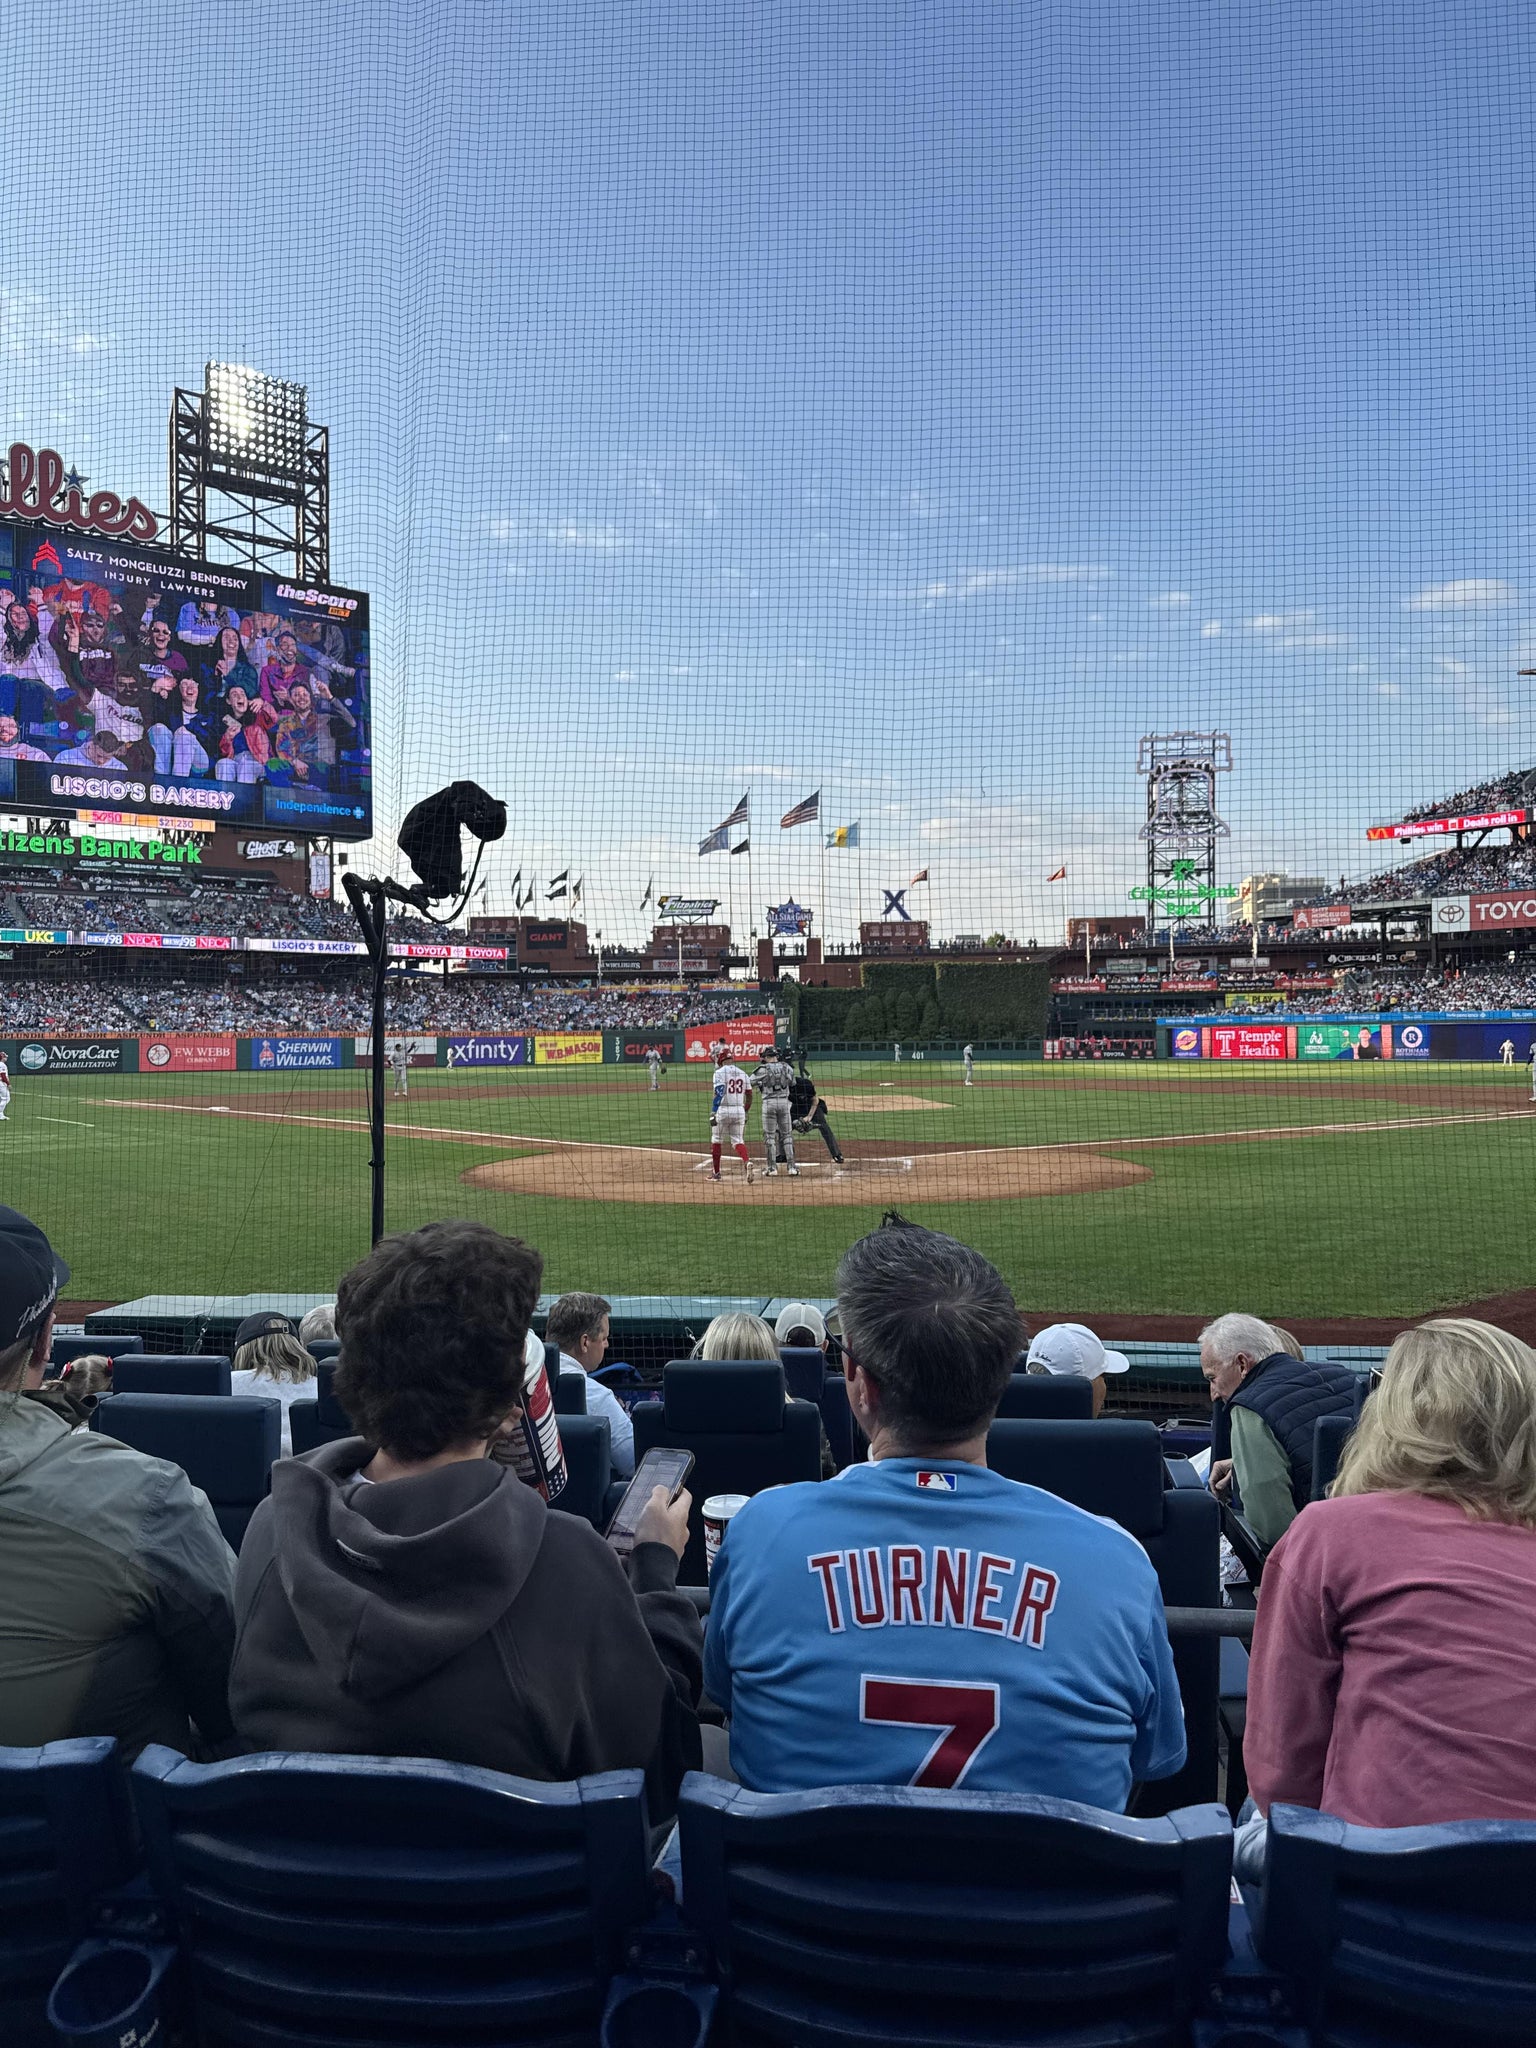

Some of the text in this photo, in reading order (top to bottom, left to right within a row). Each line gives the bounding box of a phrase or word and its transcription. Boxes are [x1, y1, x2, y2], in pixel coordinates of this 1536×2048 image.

[67, 548, 248, 590] SALTZ MONGELUZZI BENDESKY
[104, 570, 215, 598] INJURY LAWYERS
[276, 584, 358, 610] theScore
[51, 774, 235, 810] LISCIO'S BAKERY
[276, 799, 351, 816] Independence
[1463, 813, 1518, 828] Deals roll in
[1393, 823, 1443, 837] Phillies win
[0, 829, 202, 864] tizens Bank Park
[246, 840, 287, 859] GHOST
[1130, 883, 1237, 900] Citizens Bank
[1166, 901, 1200, 916] Park
[1475, 899, 1536, 921] TOYO
[766, 912, 813, 922] ALL STAR GAME
[25, 931, 54, 943] UKG
[126, 935, 158, 946] NECA
[199, 937, 230, 948] NECA
[529, 933, 564, 942] GIANT
[272, 939, 357, 952] LISCIO'S BAKERY
[411, 946, 503, 958] TOYOTA TOYOTA
[1238, 1030, 1282, 1045] Temple
[50, 1045, 120, 1060] NovaCare
[196, 1047, 230, 1057] WEBB
[277, 1041, 332, 1054] SHERWIN
[452, 1038, 520, 1062] xfinity
[1239, 1044, 1280, 1057] Health
[912, 1051, 924, 1060] 401
[50, 1061, 117, 1069] REHABILITATION
[728, 1078, 744, 1094] 33
[807, 1545, 1061, 1650] TURNER
[859, 1673, 1000, 1790] 7
